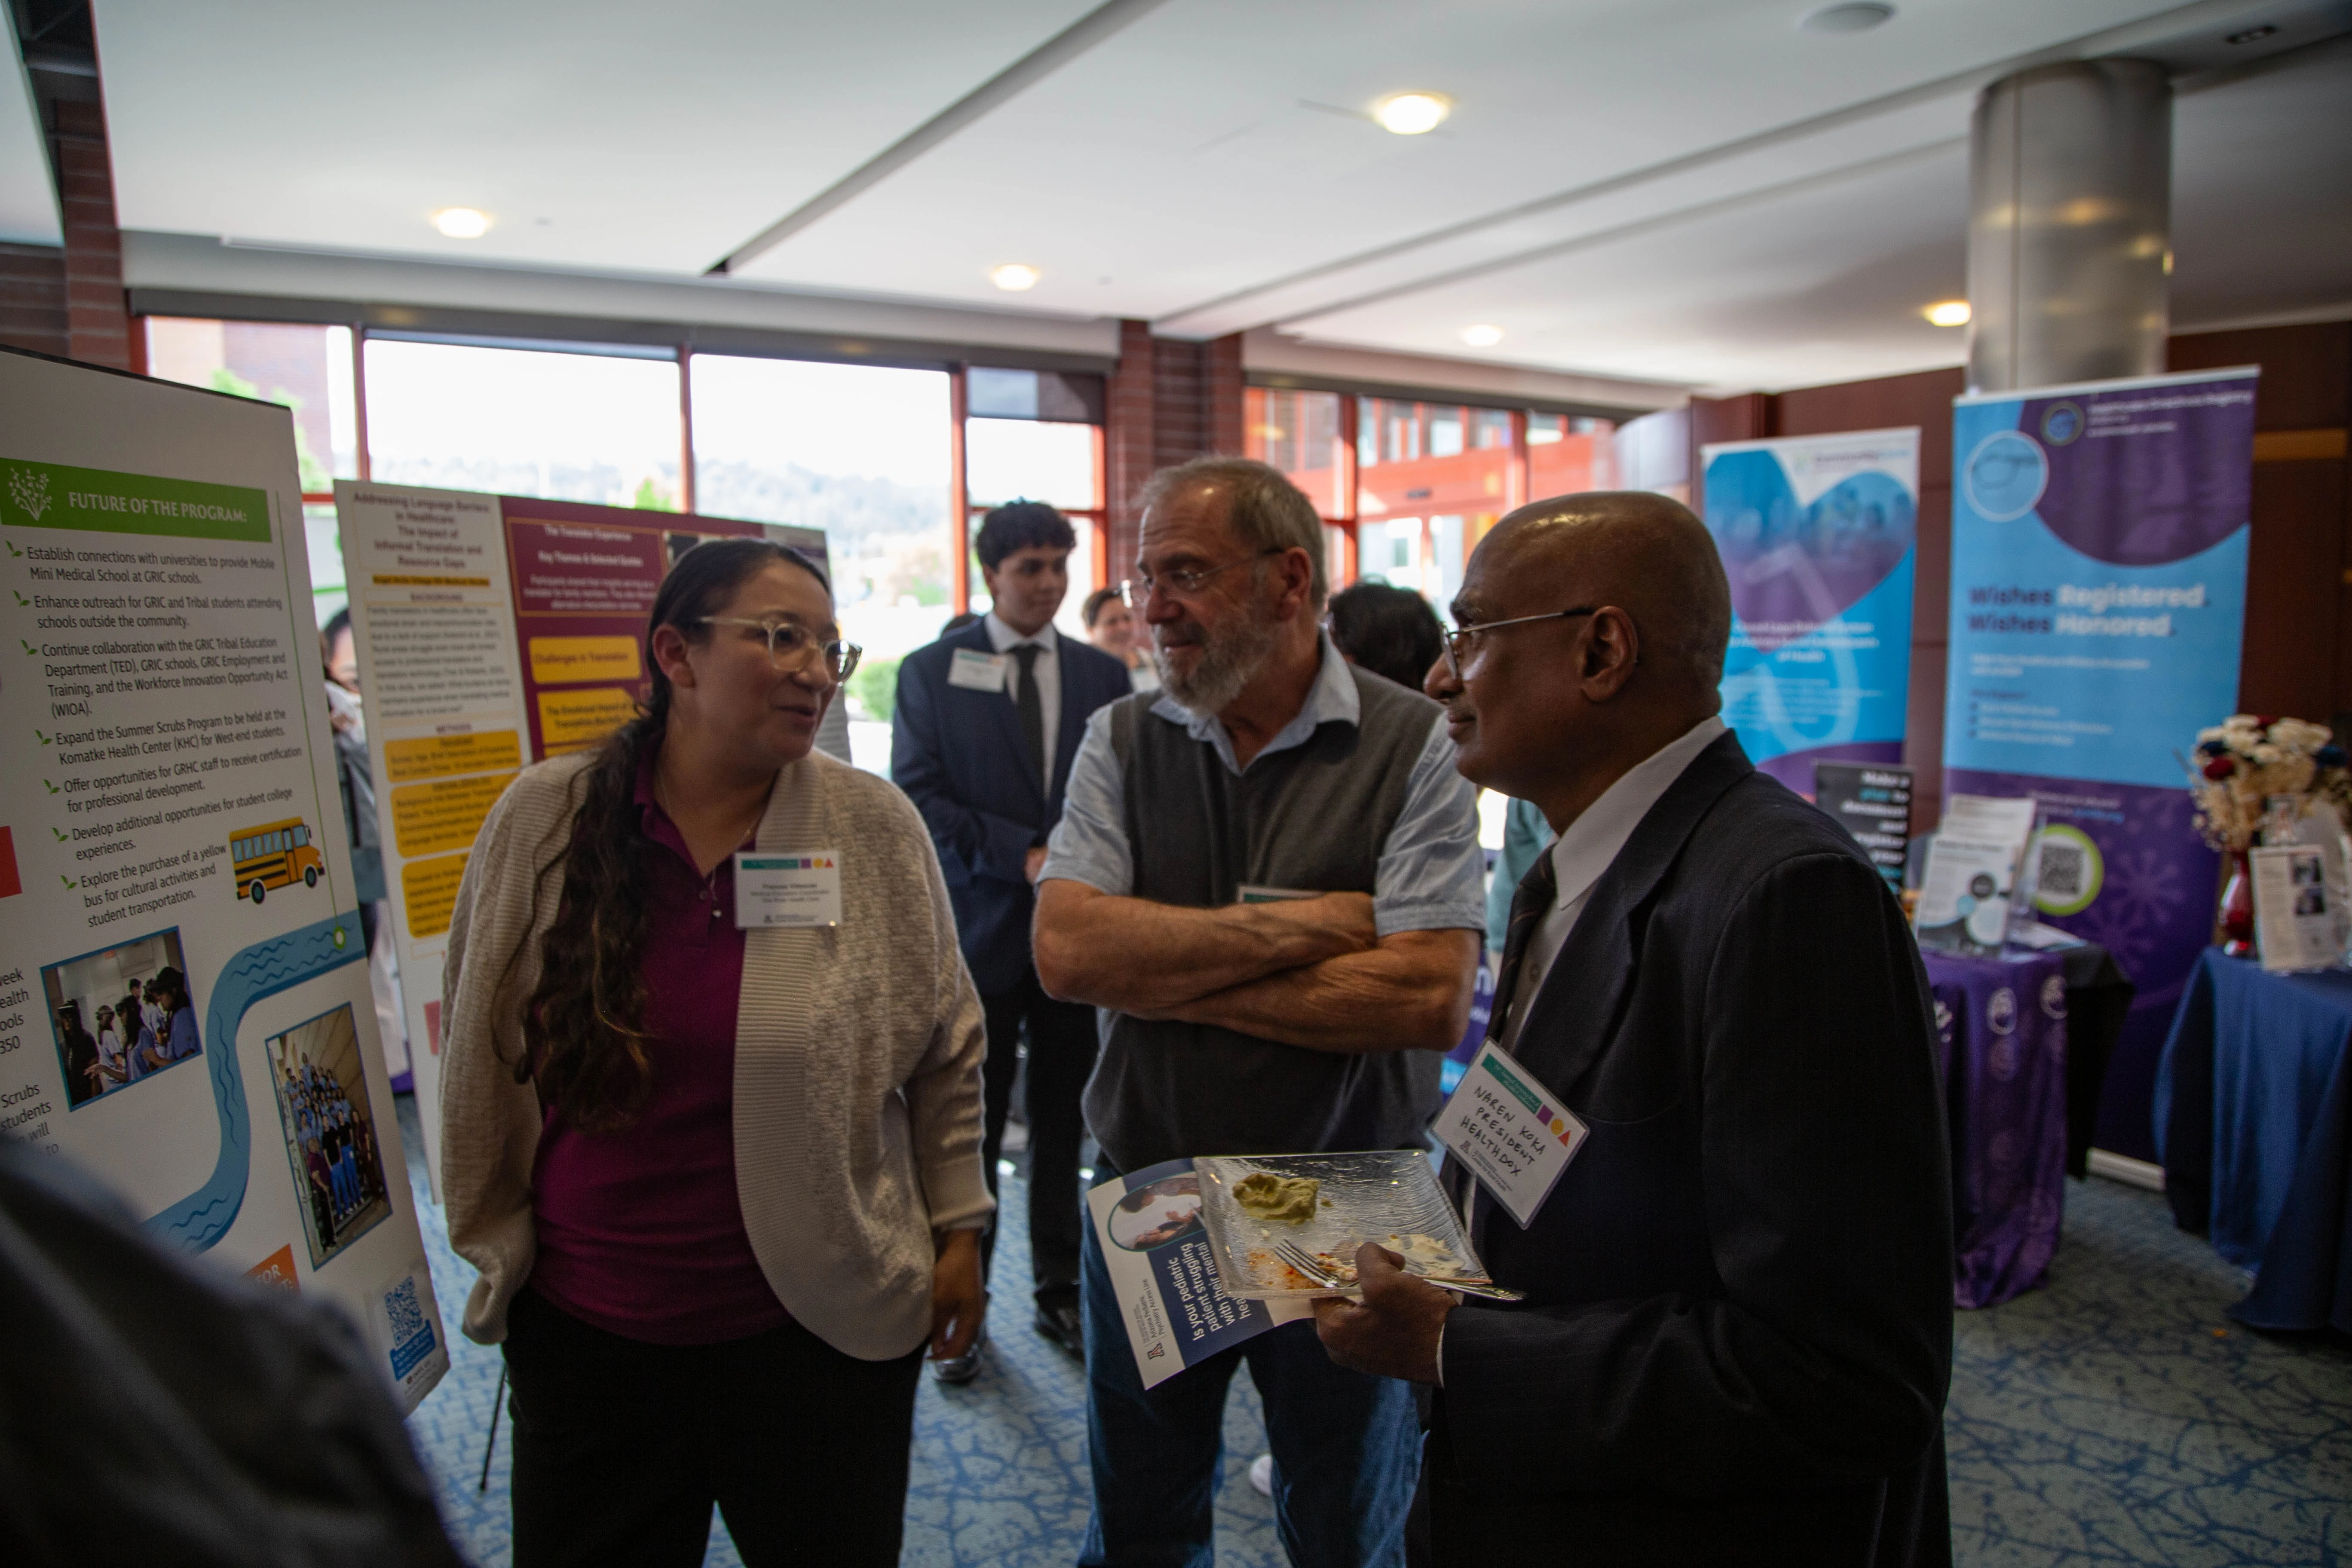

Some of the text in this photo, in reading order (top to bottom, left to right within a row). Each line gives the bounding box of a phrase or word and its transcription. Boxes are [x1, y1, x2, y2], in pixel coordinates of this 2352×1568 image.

[68, 491, 247, 522] FUTURE OF THE PROGRAM:
[27, 546, 276, 570] Establish connections with universities to provide Mobile
[30, 567, 202, 584] Mini Medical School at GRIC schools.
[34, 595, 282, 611] Enhance outreach for GRIC and Tribal students attending
[37, 614, 189, 629] schools outside the community.
[42, 637, 278, 657] Continue collaboration with the GRIC Tribal Education
[45, 652, 286, 680] Department (TED), GRIC schools, GRIC Employment and
[47, 669, 289, 698] Training, and the Workforce Innovation Opportunity Act
[51, 699, 92, 720] (WIOA).
[55, 709, 287, 747] Expand the Summer Scrubs Program to be held at the
[59, 747, 106, 765] Komatke
[107, 743, 141, 759] Health
[142, 741, 172, 754] Center
[174, 734, 199, 752] (KHC)
[200, 733, 213, 746] for
[214, 729, 251, 744] West-end
[64, 747, 303, 793] Offer opportunities for GRHC staff to receive certification
[67, 779, 205, 813] for professional development.
[72, 787, 293, 841] Develop additional opportunities for student college
[76, 839, 137, 861] experiences.
[80, 844, 227, 889] Explore the purchase of a yellow
[83, 862, 217, 908] bus for cultural activities and
[87, 889, 197, 928] student transportation.
[0, 988, 30, 1009] ealth
[1, 1084, 40, 1108] Scrubs
[0, 1101, 52, 1132] students
[28, 1121, 51, 1141] will
[1473, 1085, 1516, 1123] NAREN
[1519, 1125, 1546, 1156] KOKA
[1475, 1107, 1536, 1165] PRESIDENT
[1168, 1257, 1206, 1341] Is your pediatric
[1181, 1243, 1224, 1333] patient struggling
[1195, 1242, 1236, 1326] with their mental
